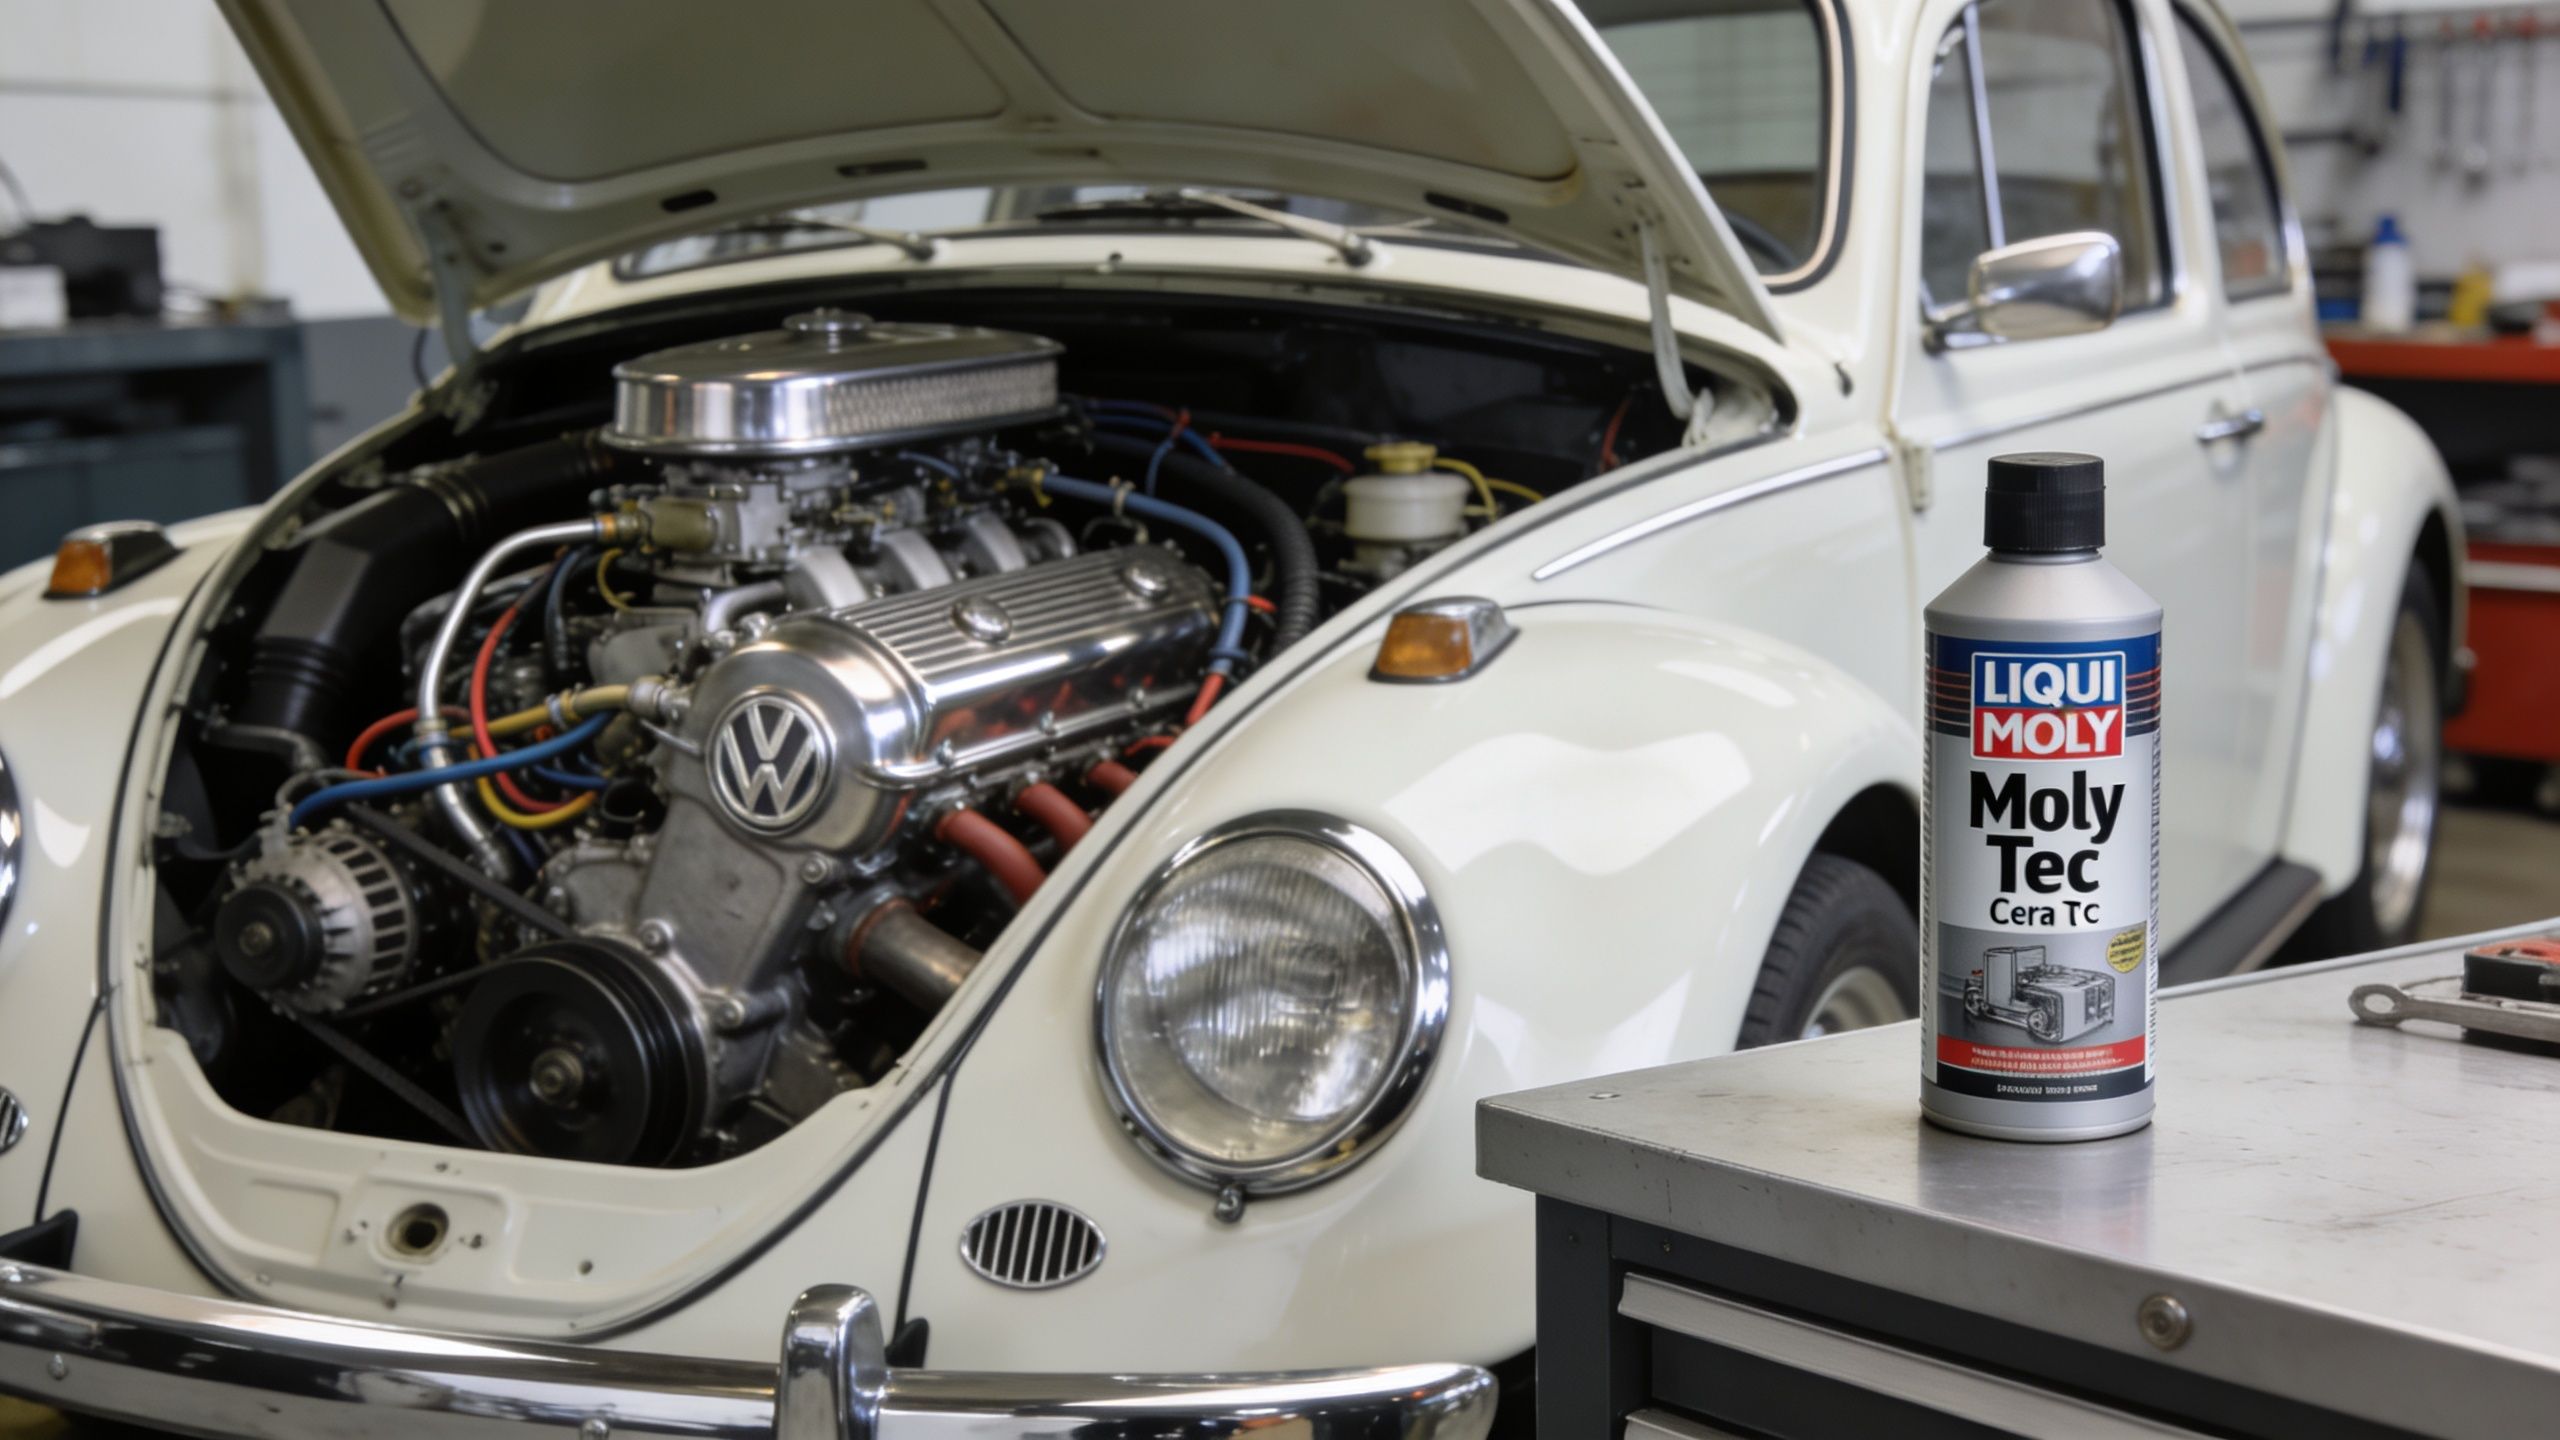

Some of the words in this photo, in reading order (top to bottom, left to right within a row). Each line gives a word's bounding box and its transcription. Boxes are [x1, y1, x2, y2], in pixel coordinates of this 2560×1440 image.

[1983, 660, 2116, 708] LIQUI
[1982, 709, 2119, 755] MOLY
[1970, 770, 2126, 844] Moly
[1986, 834, 2100, 894] Tec
[1990, 897, 2055, 927] Cera
